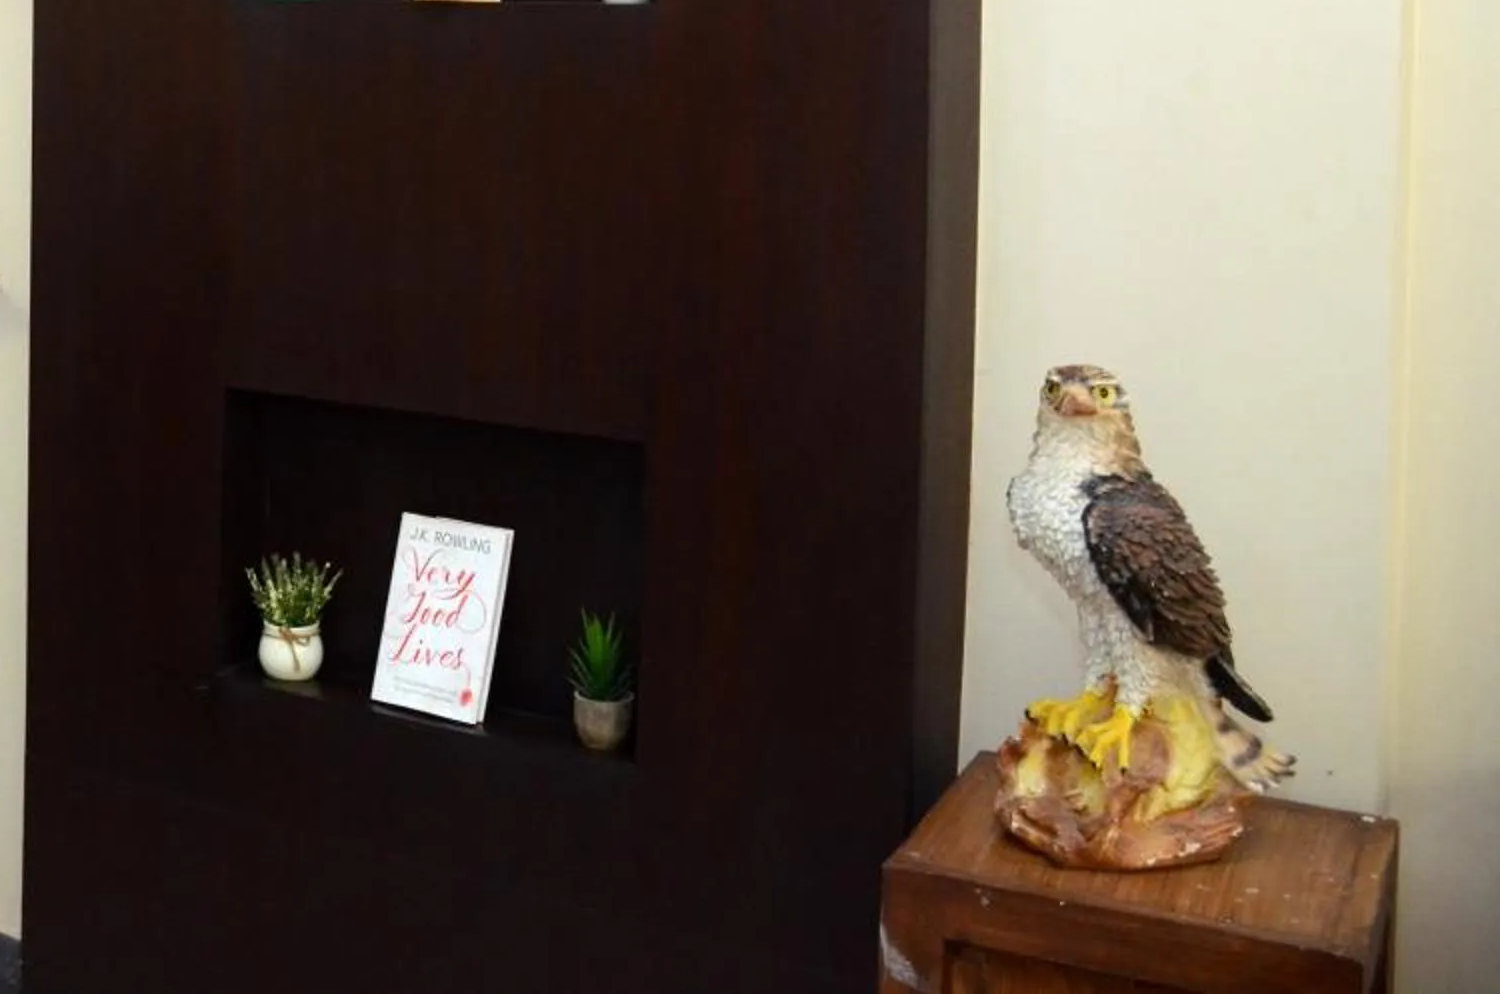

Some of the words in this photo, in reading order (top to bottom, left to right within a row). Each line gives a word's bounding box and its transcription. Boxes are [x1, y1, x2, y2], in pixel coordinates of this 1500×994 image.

[434, 530, 491, 555] ROWLING
[406, 546, 476, 601] Very
[391, 623, 464, 670] Lives
